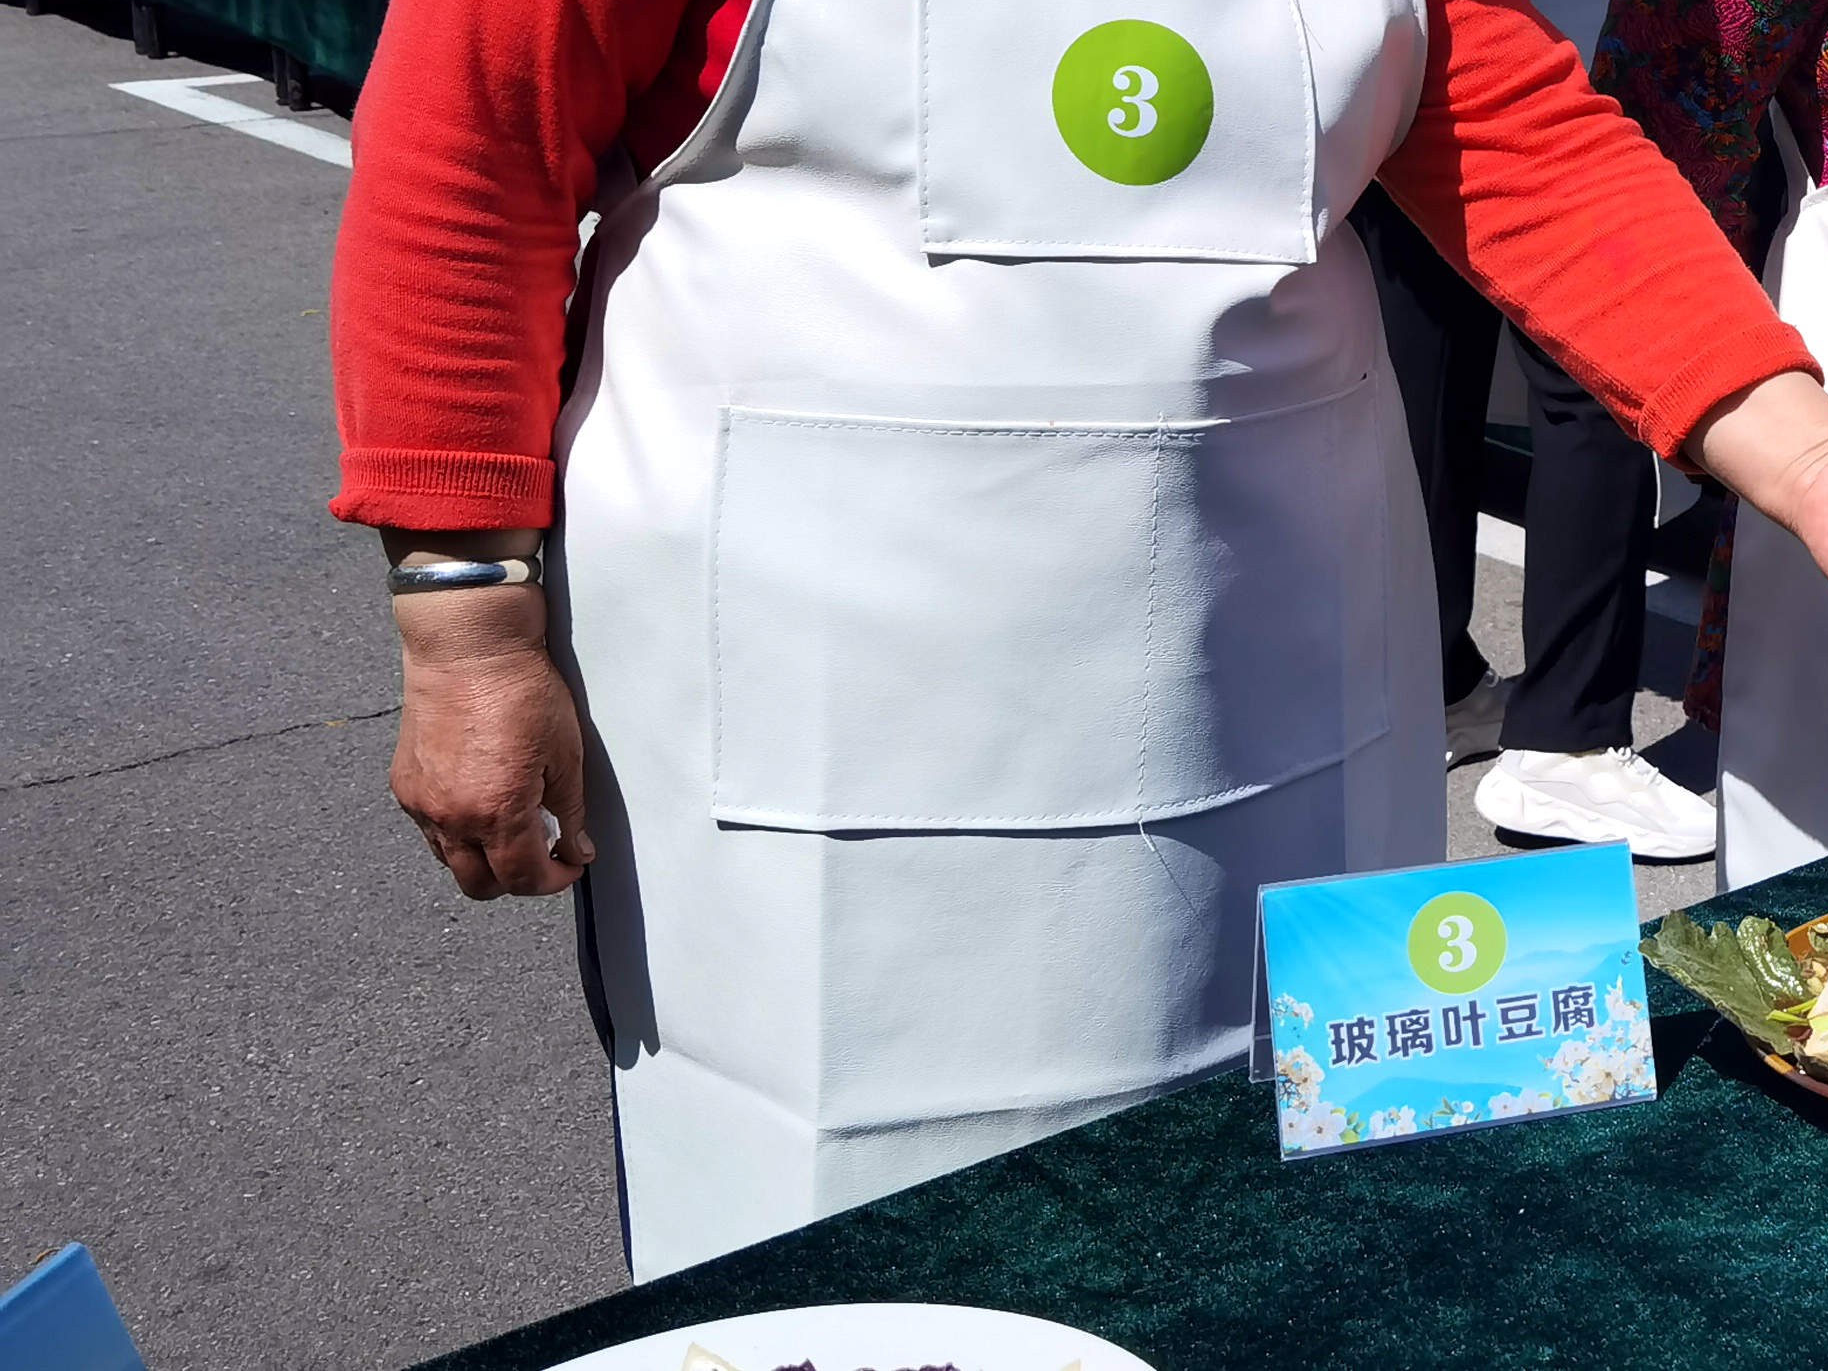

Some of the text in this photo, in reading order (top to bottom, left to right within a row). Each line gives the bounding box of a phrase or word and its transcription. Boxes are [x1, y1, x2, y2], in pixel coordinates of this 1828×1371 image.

[1107, 64, 1160, 139] 3
[1437, 914, 1478, 973] 3
[1328, 984, 1598, 1068] 玻璃叶豆腐
